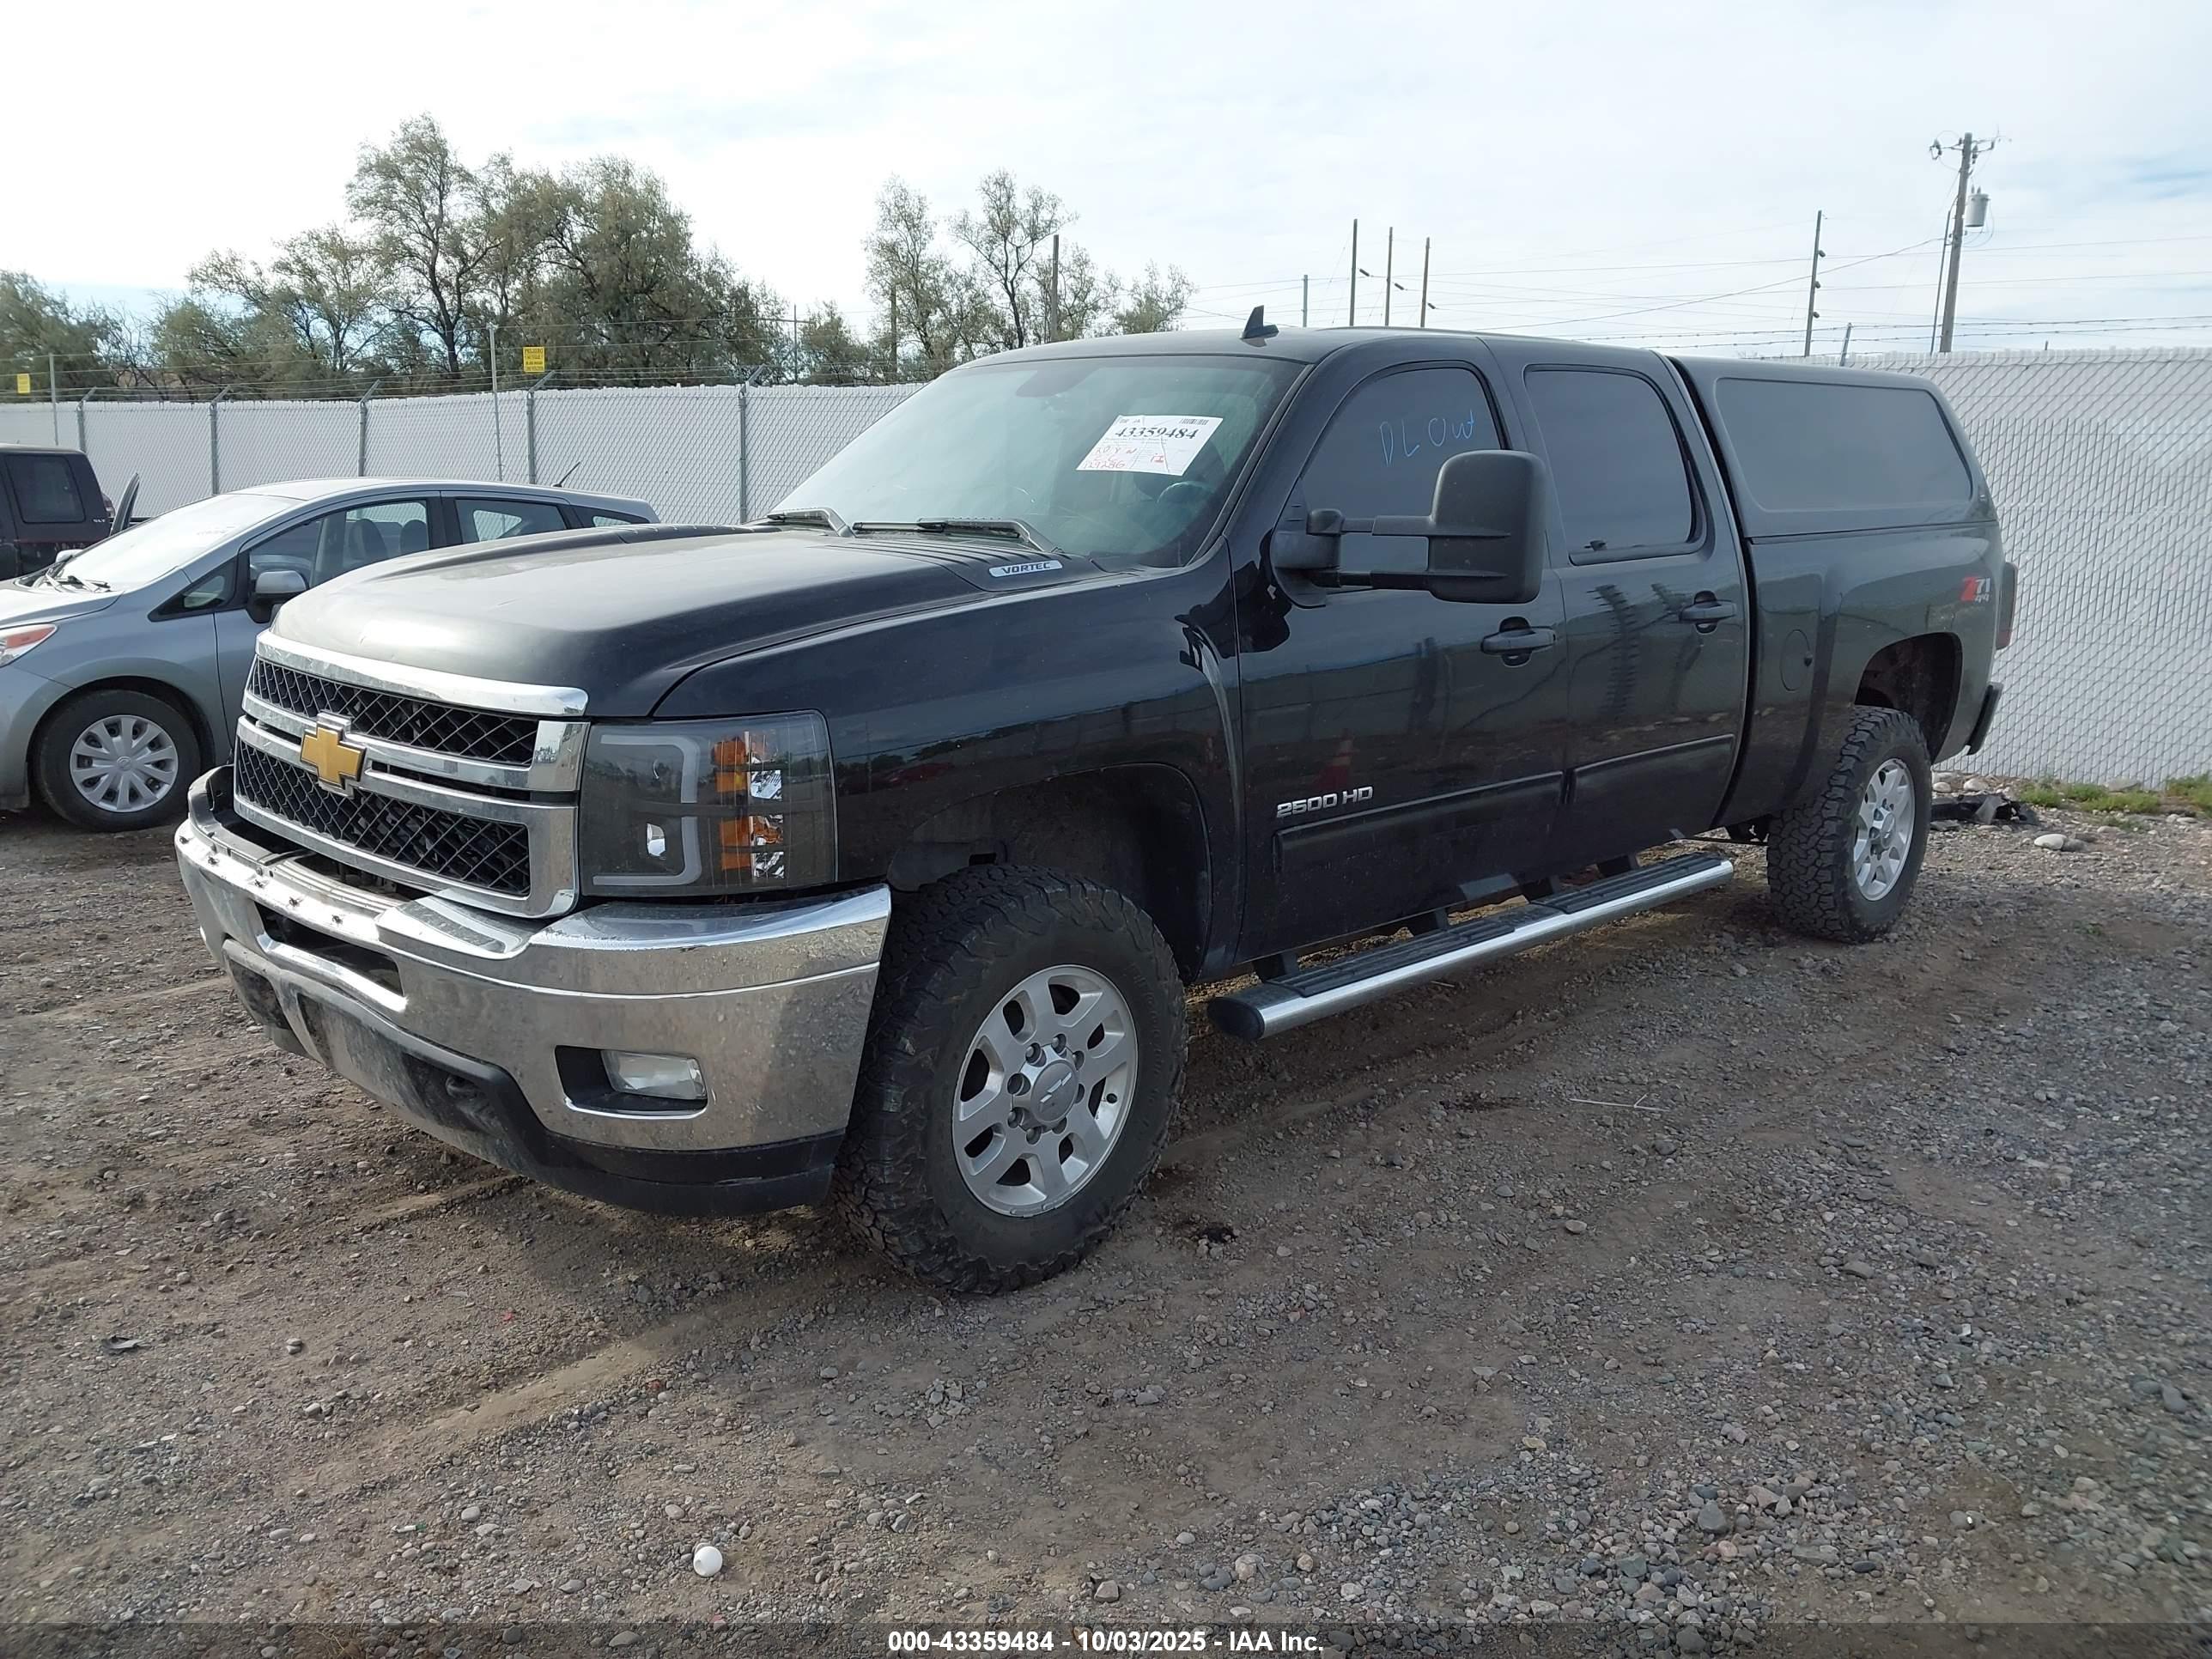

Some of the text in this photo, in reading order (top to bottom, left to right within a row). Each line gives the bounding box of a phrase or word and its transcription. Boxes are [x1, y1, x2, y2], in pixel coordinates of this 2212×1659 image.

[1115, 427, 1199, 439] 43359484
[1379, 420, 1420, 466] DL
[1001, 562, 1050, 574] VORTEC
[1960, 576, 1991, 601] Z71
[1276, 786, 1373, 818] 2500 HD
